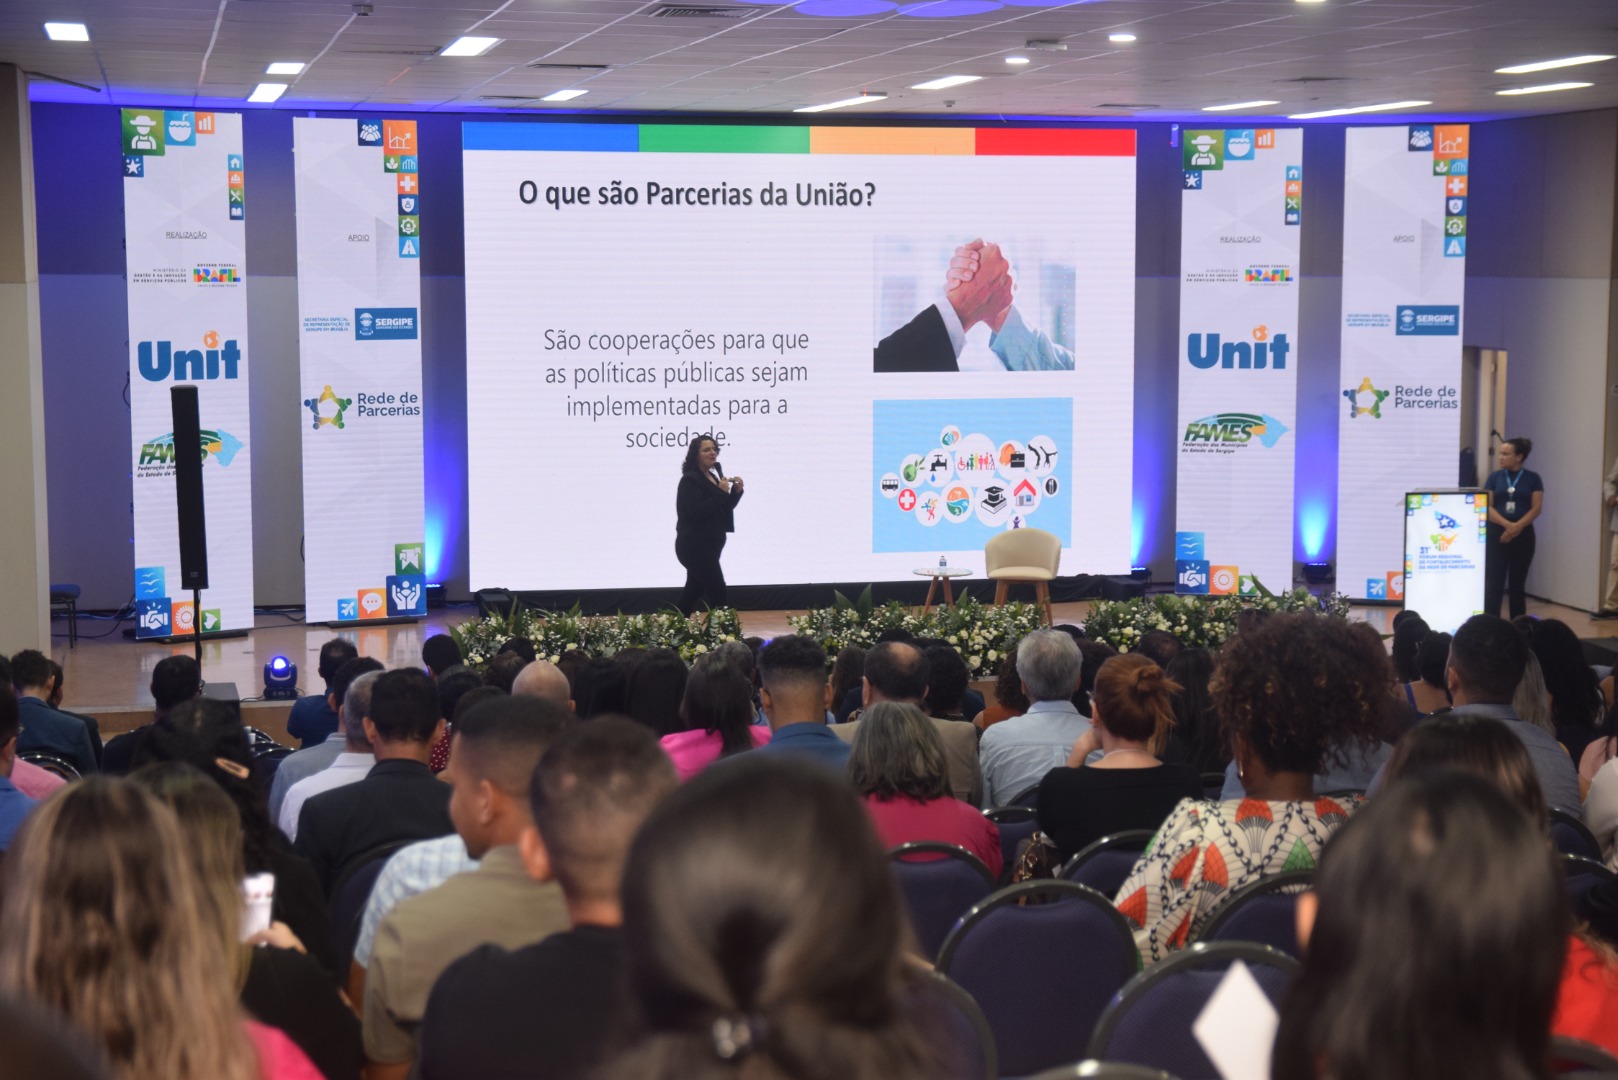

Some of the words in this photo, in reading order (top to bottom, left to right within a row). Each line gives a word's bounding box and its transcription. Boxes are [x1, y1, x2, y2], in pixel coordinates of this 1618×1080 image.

[519, 180, 538, 205] O
[546, 185, 591, 210] que
[599, 180, 639, 205] são
[647, 181, 752, 206] Parcerias
[760, 182, 788, 206] da
[796, 181, 876, 207] União?
[165, 231, 207, 239] REALIZAÇÃO
[348, 234, 370, 242] APOIO
[1220, 236, 1261, 244] REALIZAÇÃO
[1393, 235, 1415, 243] APOIO
[193, 268, 241, 282] BRASIL
[1245, 269, 1293, 282] BRASIL
[375, 317, 413, 326] SERGIPE
[1416, 314, 1455, 323] SERGIPE
[544, 329, 581, 350] São
[588, 329, 716, 355] cooperações
[723, 333, 766, 355] para
[773, 333, 809, 355] que
[1187, 325, 1290, 369] Unit
[137, 330, 241, 382] Unit
[545, 366, 567, 383] as
[574, 361, 657, 390] políticas
[664, 361, 745, 388] públicas
[752, 361, 808, 388] sejam
[358, 392, 395, 405] Rede
[399, 391, 418, 404] de
[1395, 385, 1433, 397] Rede
[1437, 385, 1456, 397] de
[567, 394, 721, 422] implementadas
[728, 398, 770, 420] para
[777, 398, 788, 414] a
[1395, 396, 1458, 409] Parcerias
[358, 403, 420, 417] Parcerias
[1184, 423, 1254, 443] FAMES
